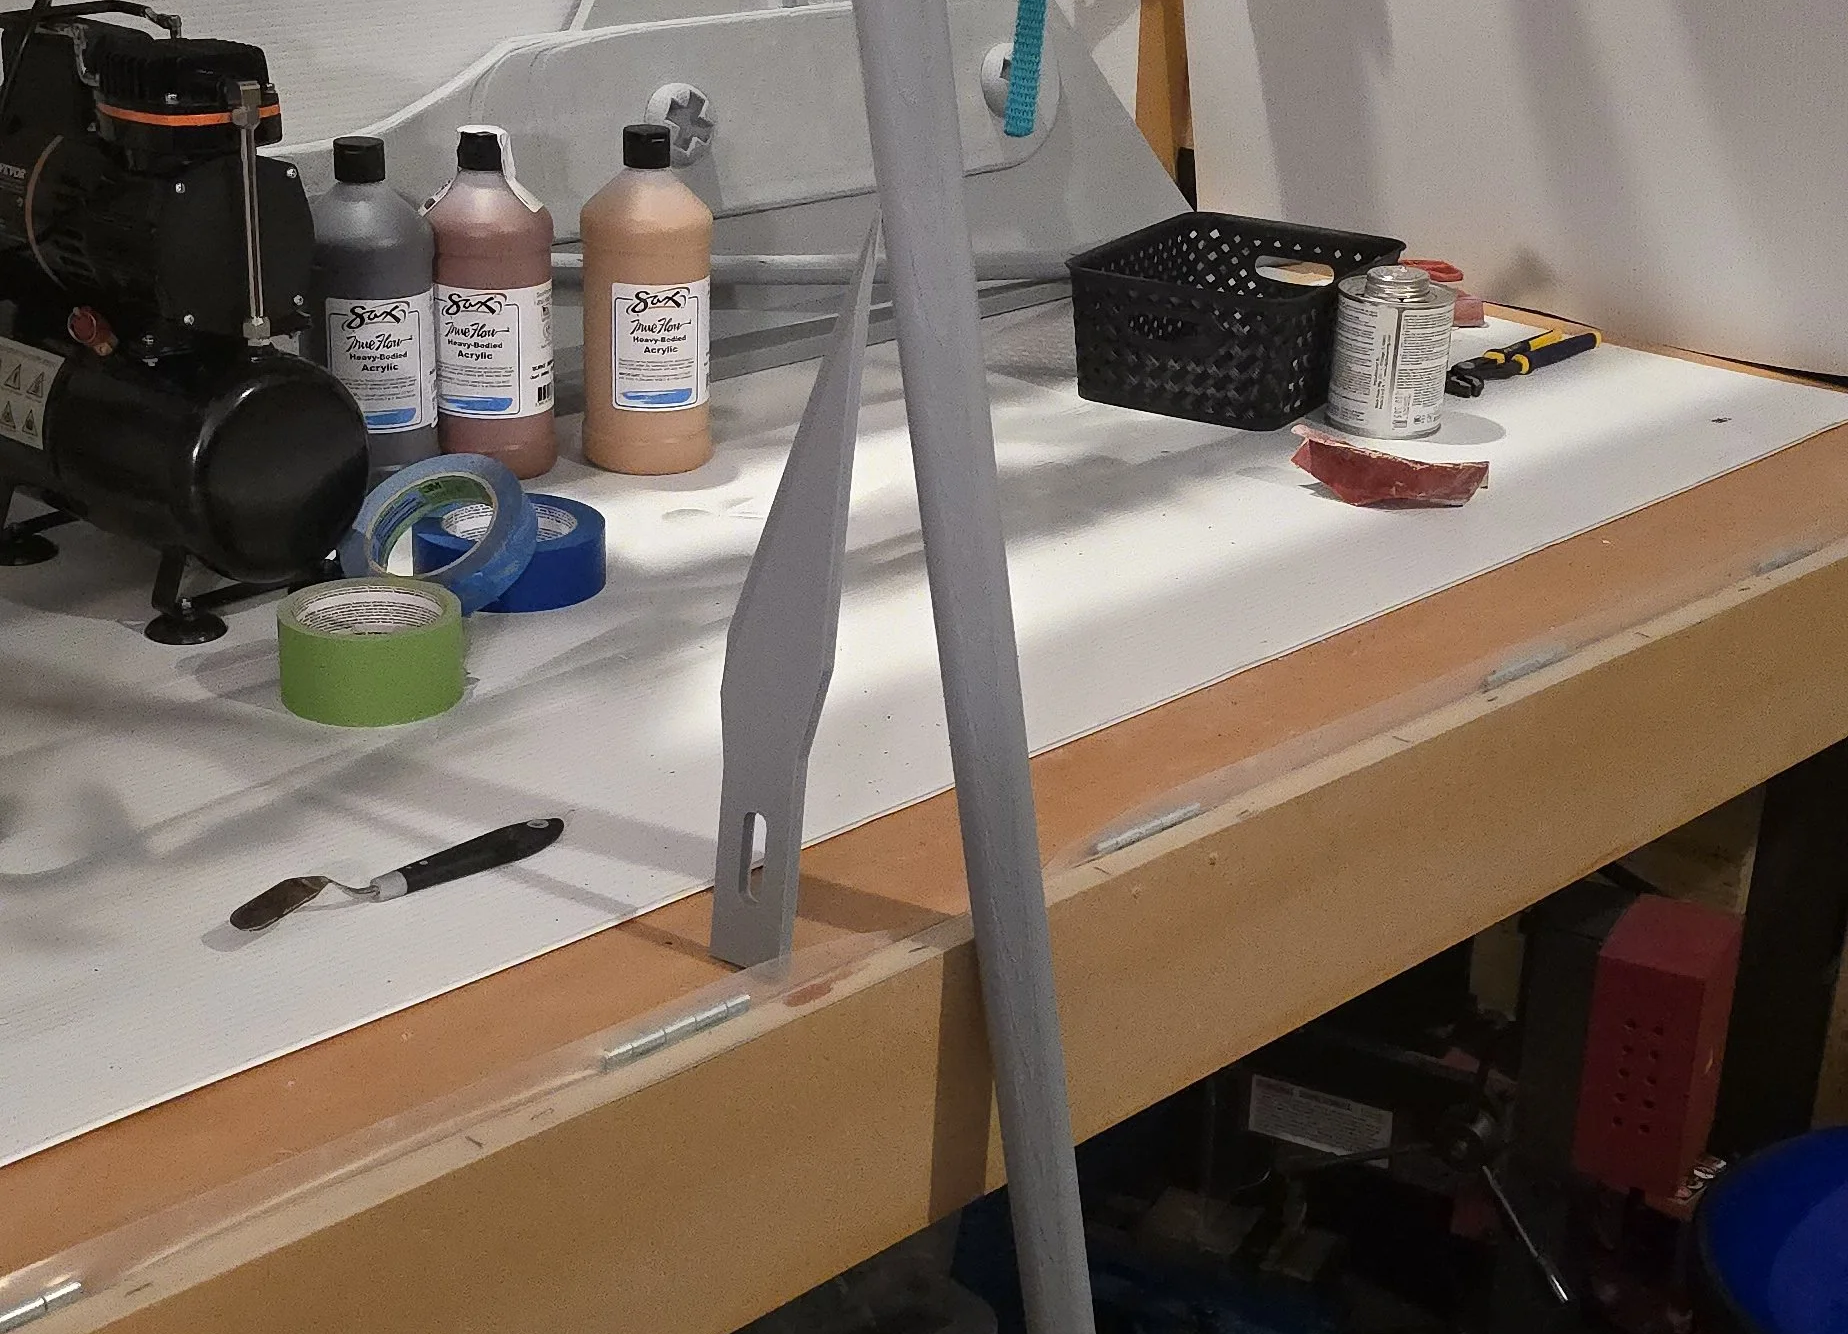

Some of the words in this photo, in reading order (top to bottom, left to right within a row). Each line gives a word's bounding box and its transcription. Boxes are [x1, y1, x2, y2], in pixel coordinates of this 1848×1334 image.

[445, 293, 497, 315] Sax
[631, 290, 682, 314] Sax
[346, 305, 402, 329] Sax
[447, 338, 503, 349] Heavy-Bodied
[349, 351, 408, 361] Heavy-Bodied
[457, 350, 493, 361] Acrylic
[643, 346, 679, 356] Acrylic
[361, 363, 399, 373] Acrylic
